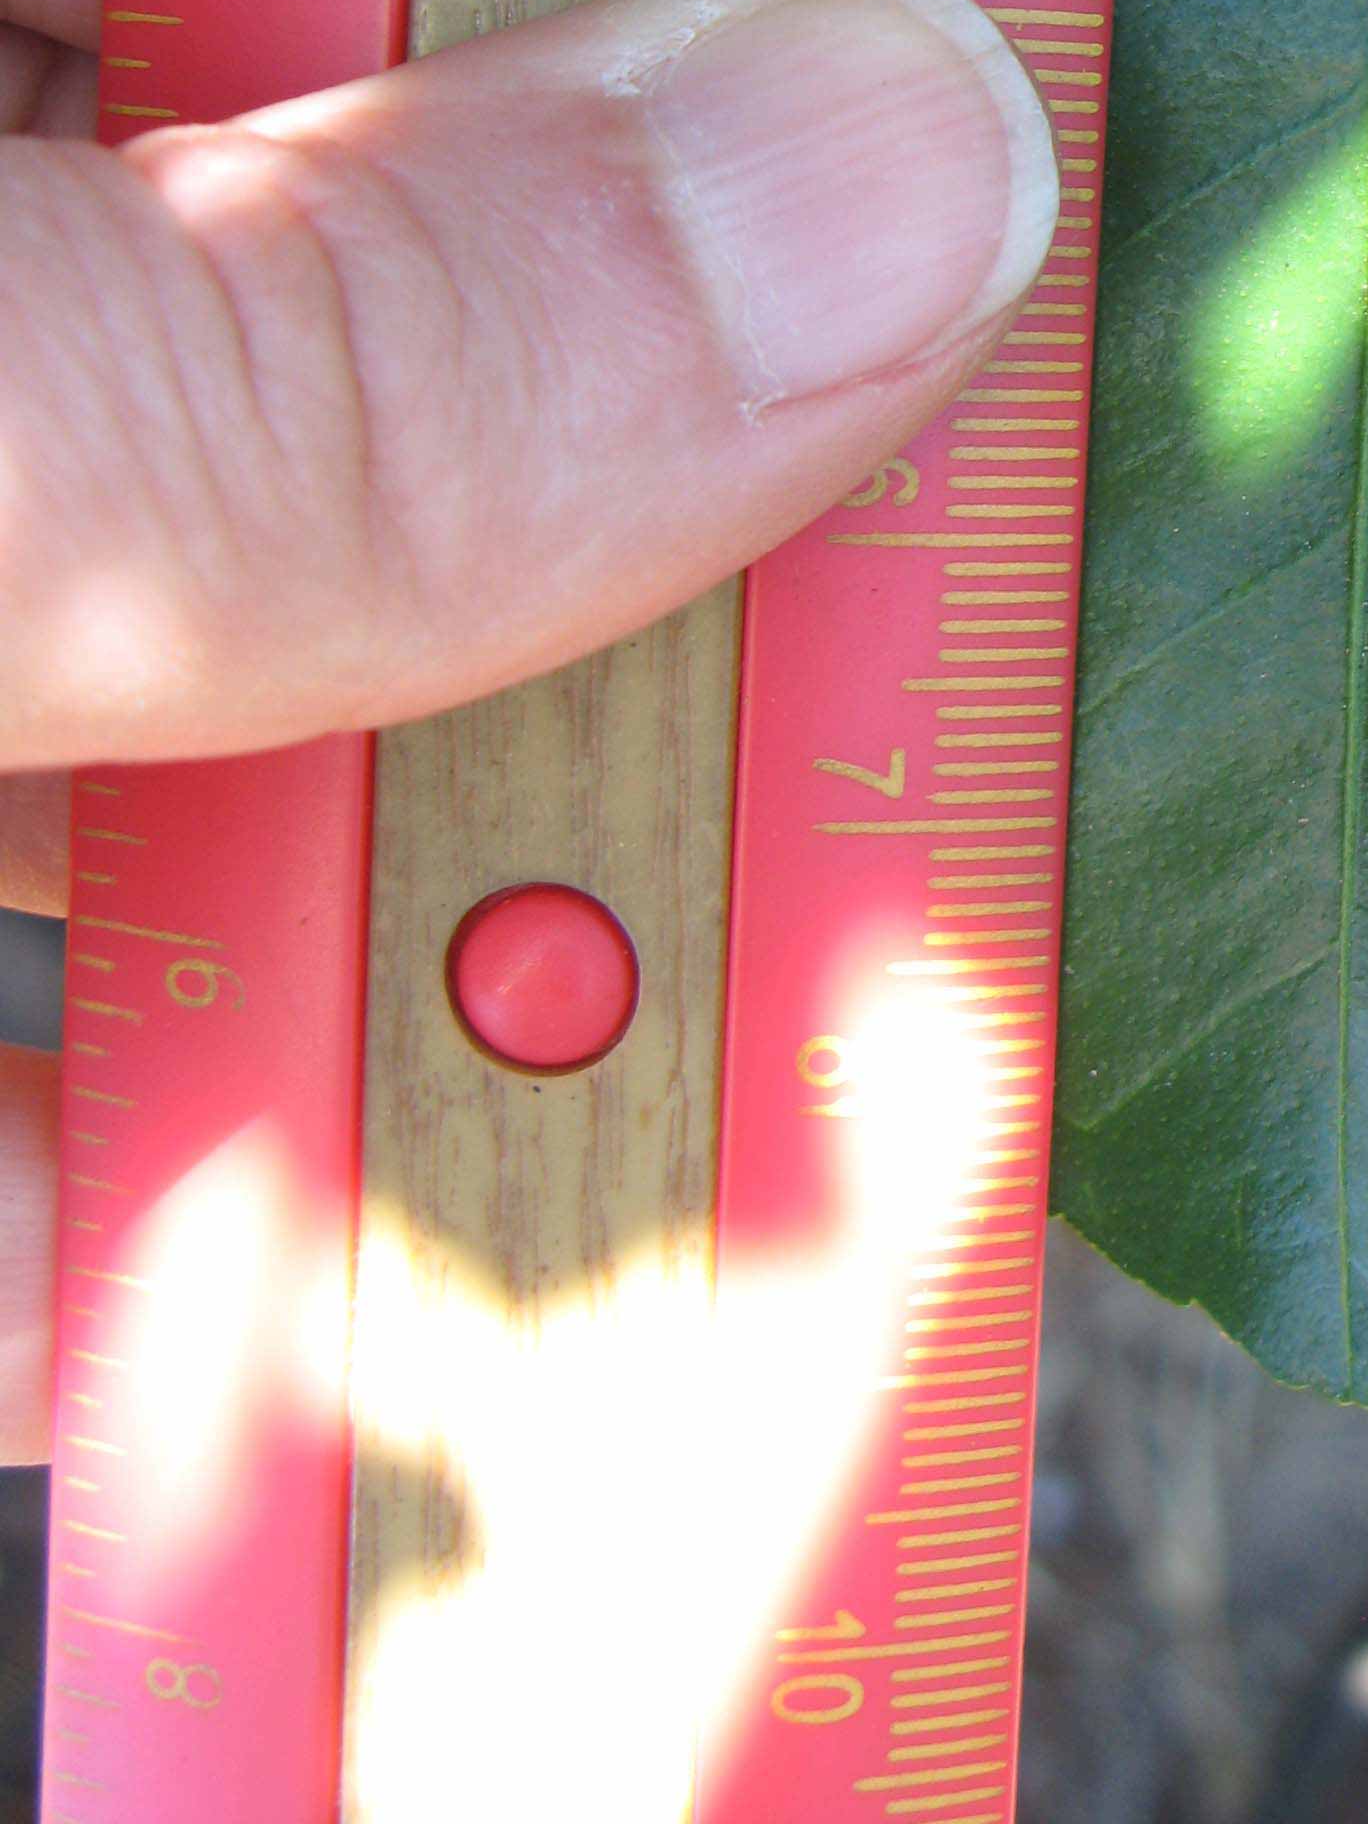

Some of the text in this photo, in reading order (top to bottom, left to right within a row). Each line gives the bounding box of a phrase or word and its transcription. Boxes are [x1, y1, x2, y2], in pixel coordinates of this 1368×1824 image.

[812, 747, 906, 799] 7
[165, 958, 246, 1013] 9
[145, 1657, 224, 1712] 8
[770, 1609, 867, 1725] 10
